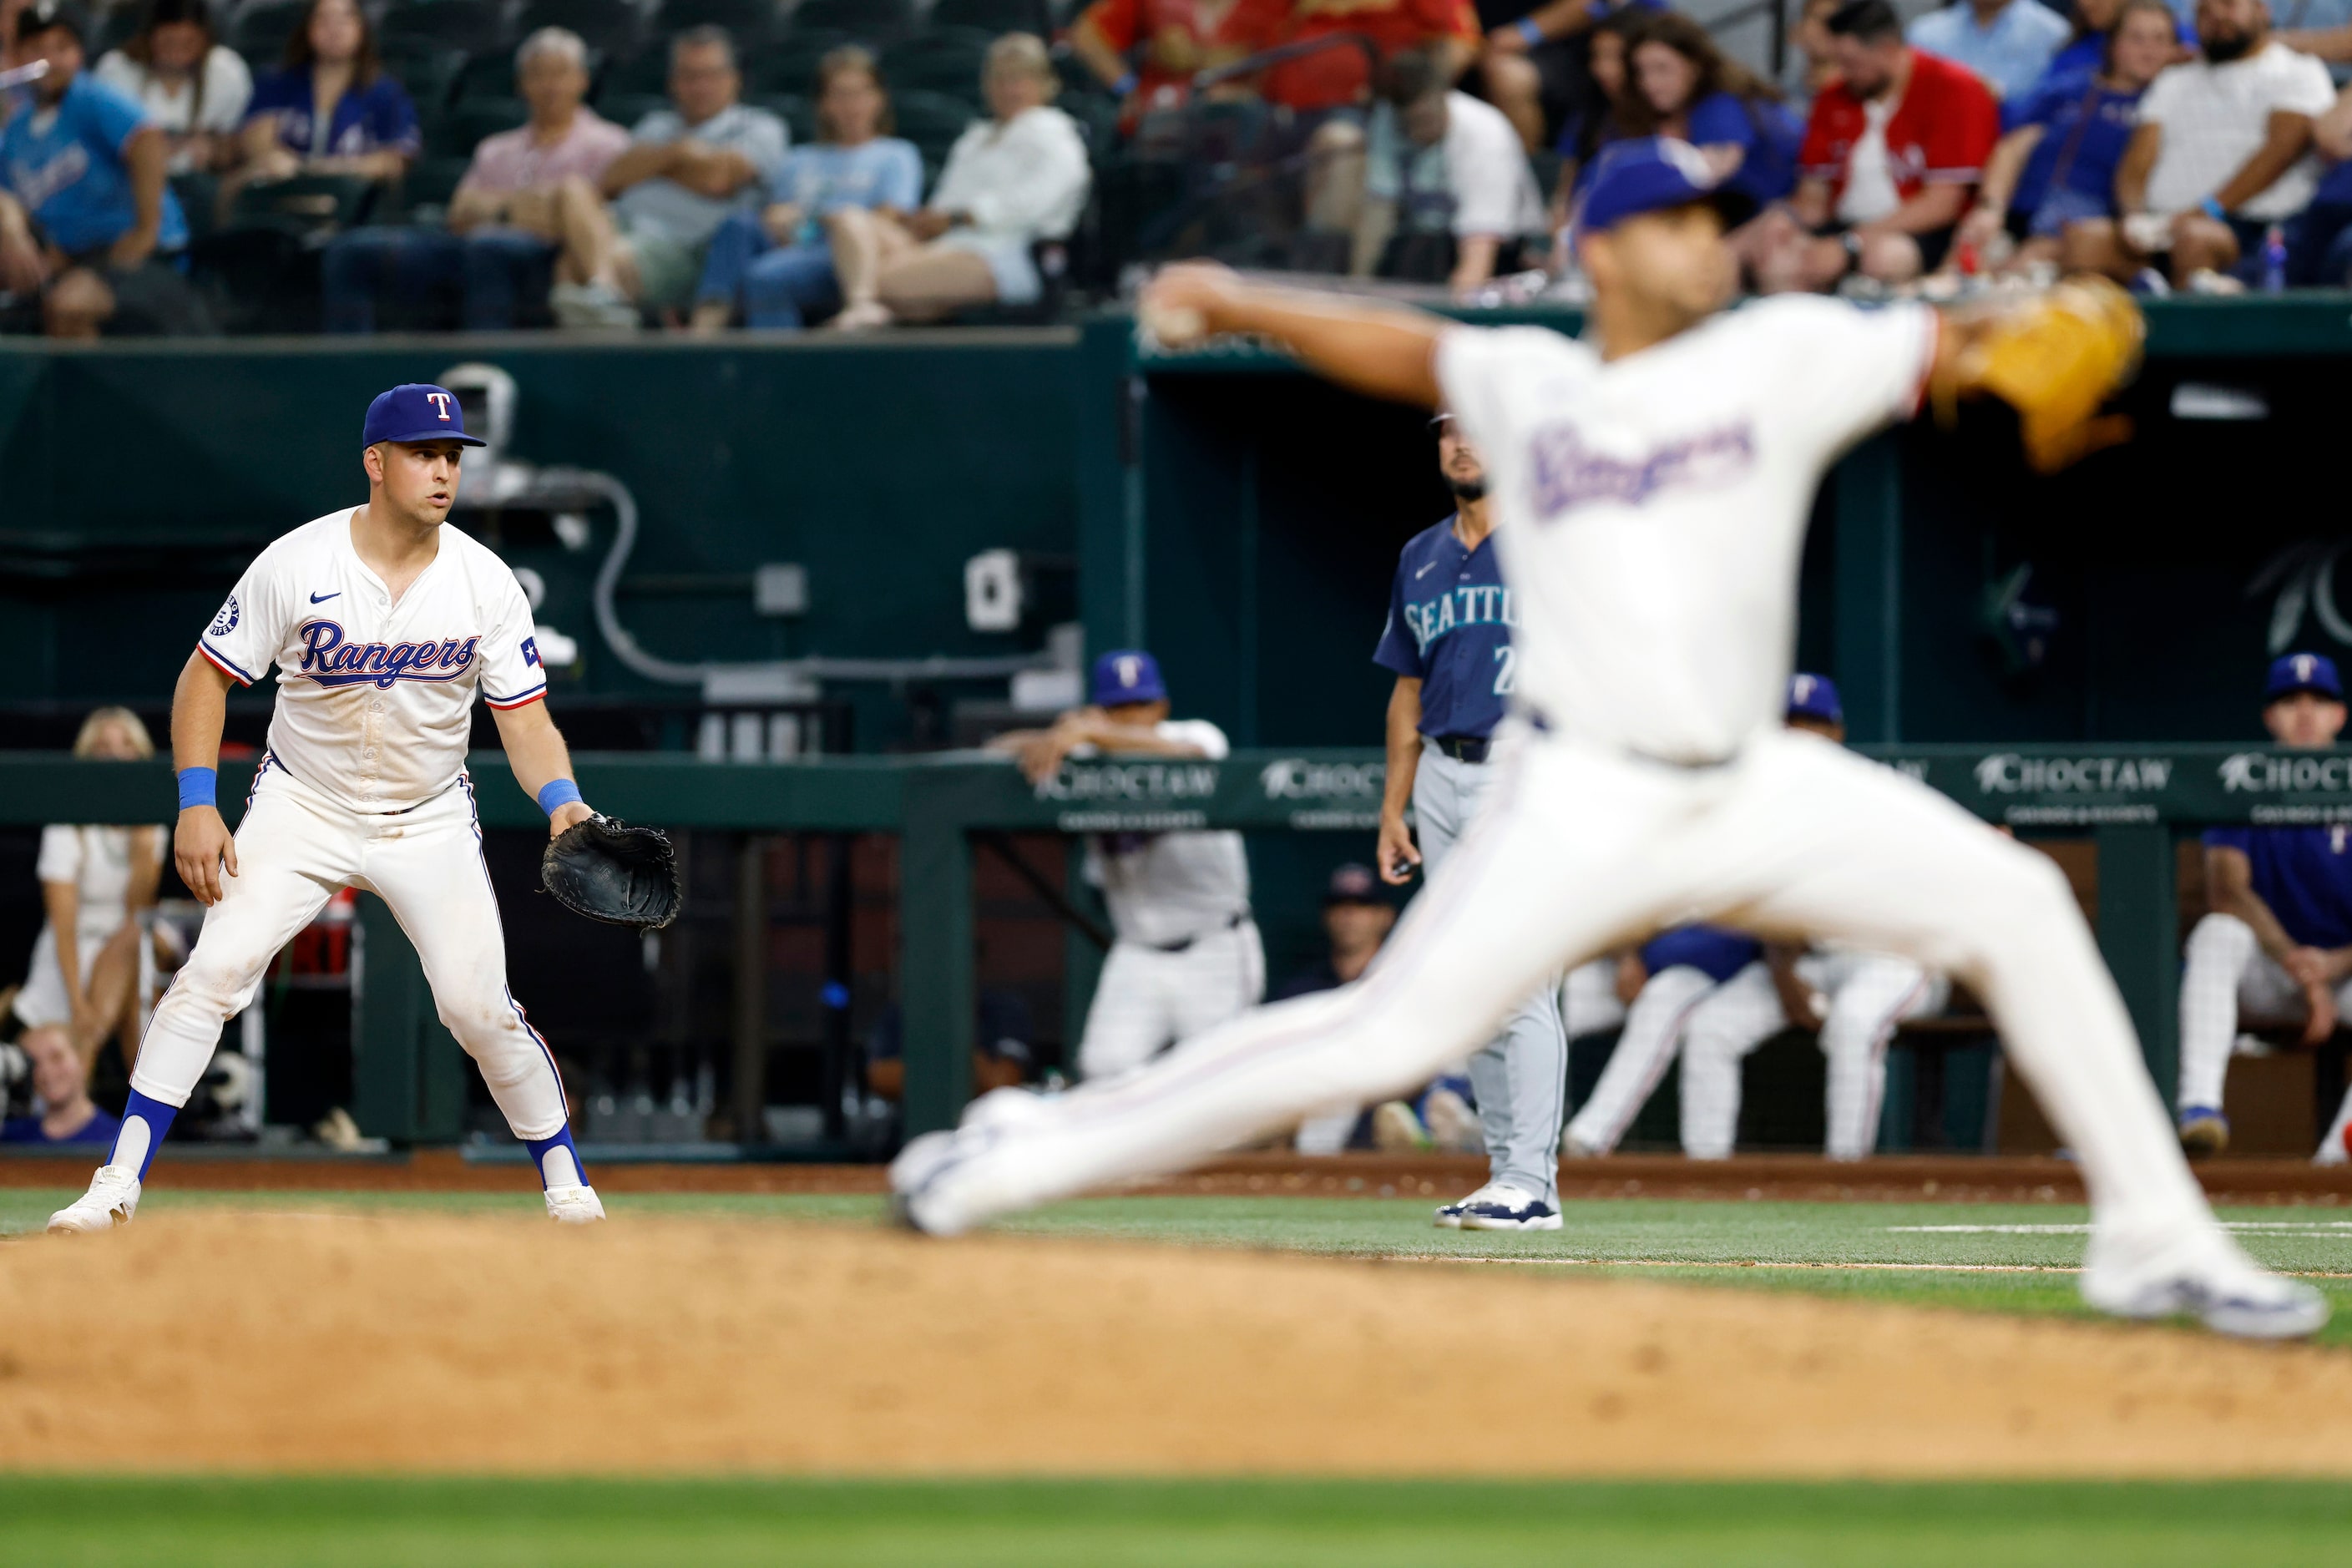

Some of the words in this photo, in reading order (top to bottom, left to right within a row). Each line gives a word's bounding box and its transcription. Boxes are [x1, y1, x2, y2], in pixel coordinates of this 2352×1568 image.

[427, 392, 452, 421] T
[1404, 584, 1520, 658] SEATTL
[297, 619, 483, 690] Rangers
[1052, 761, 1219, 800] CHOCTAW
[1284, 758, 1387, 799] CHOC
[1998, 752, 2173, 794] CHOCTAW
[2243, 751, 2352, 793] CHOC
